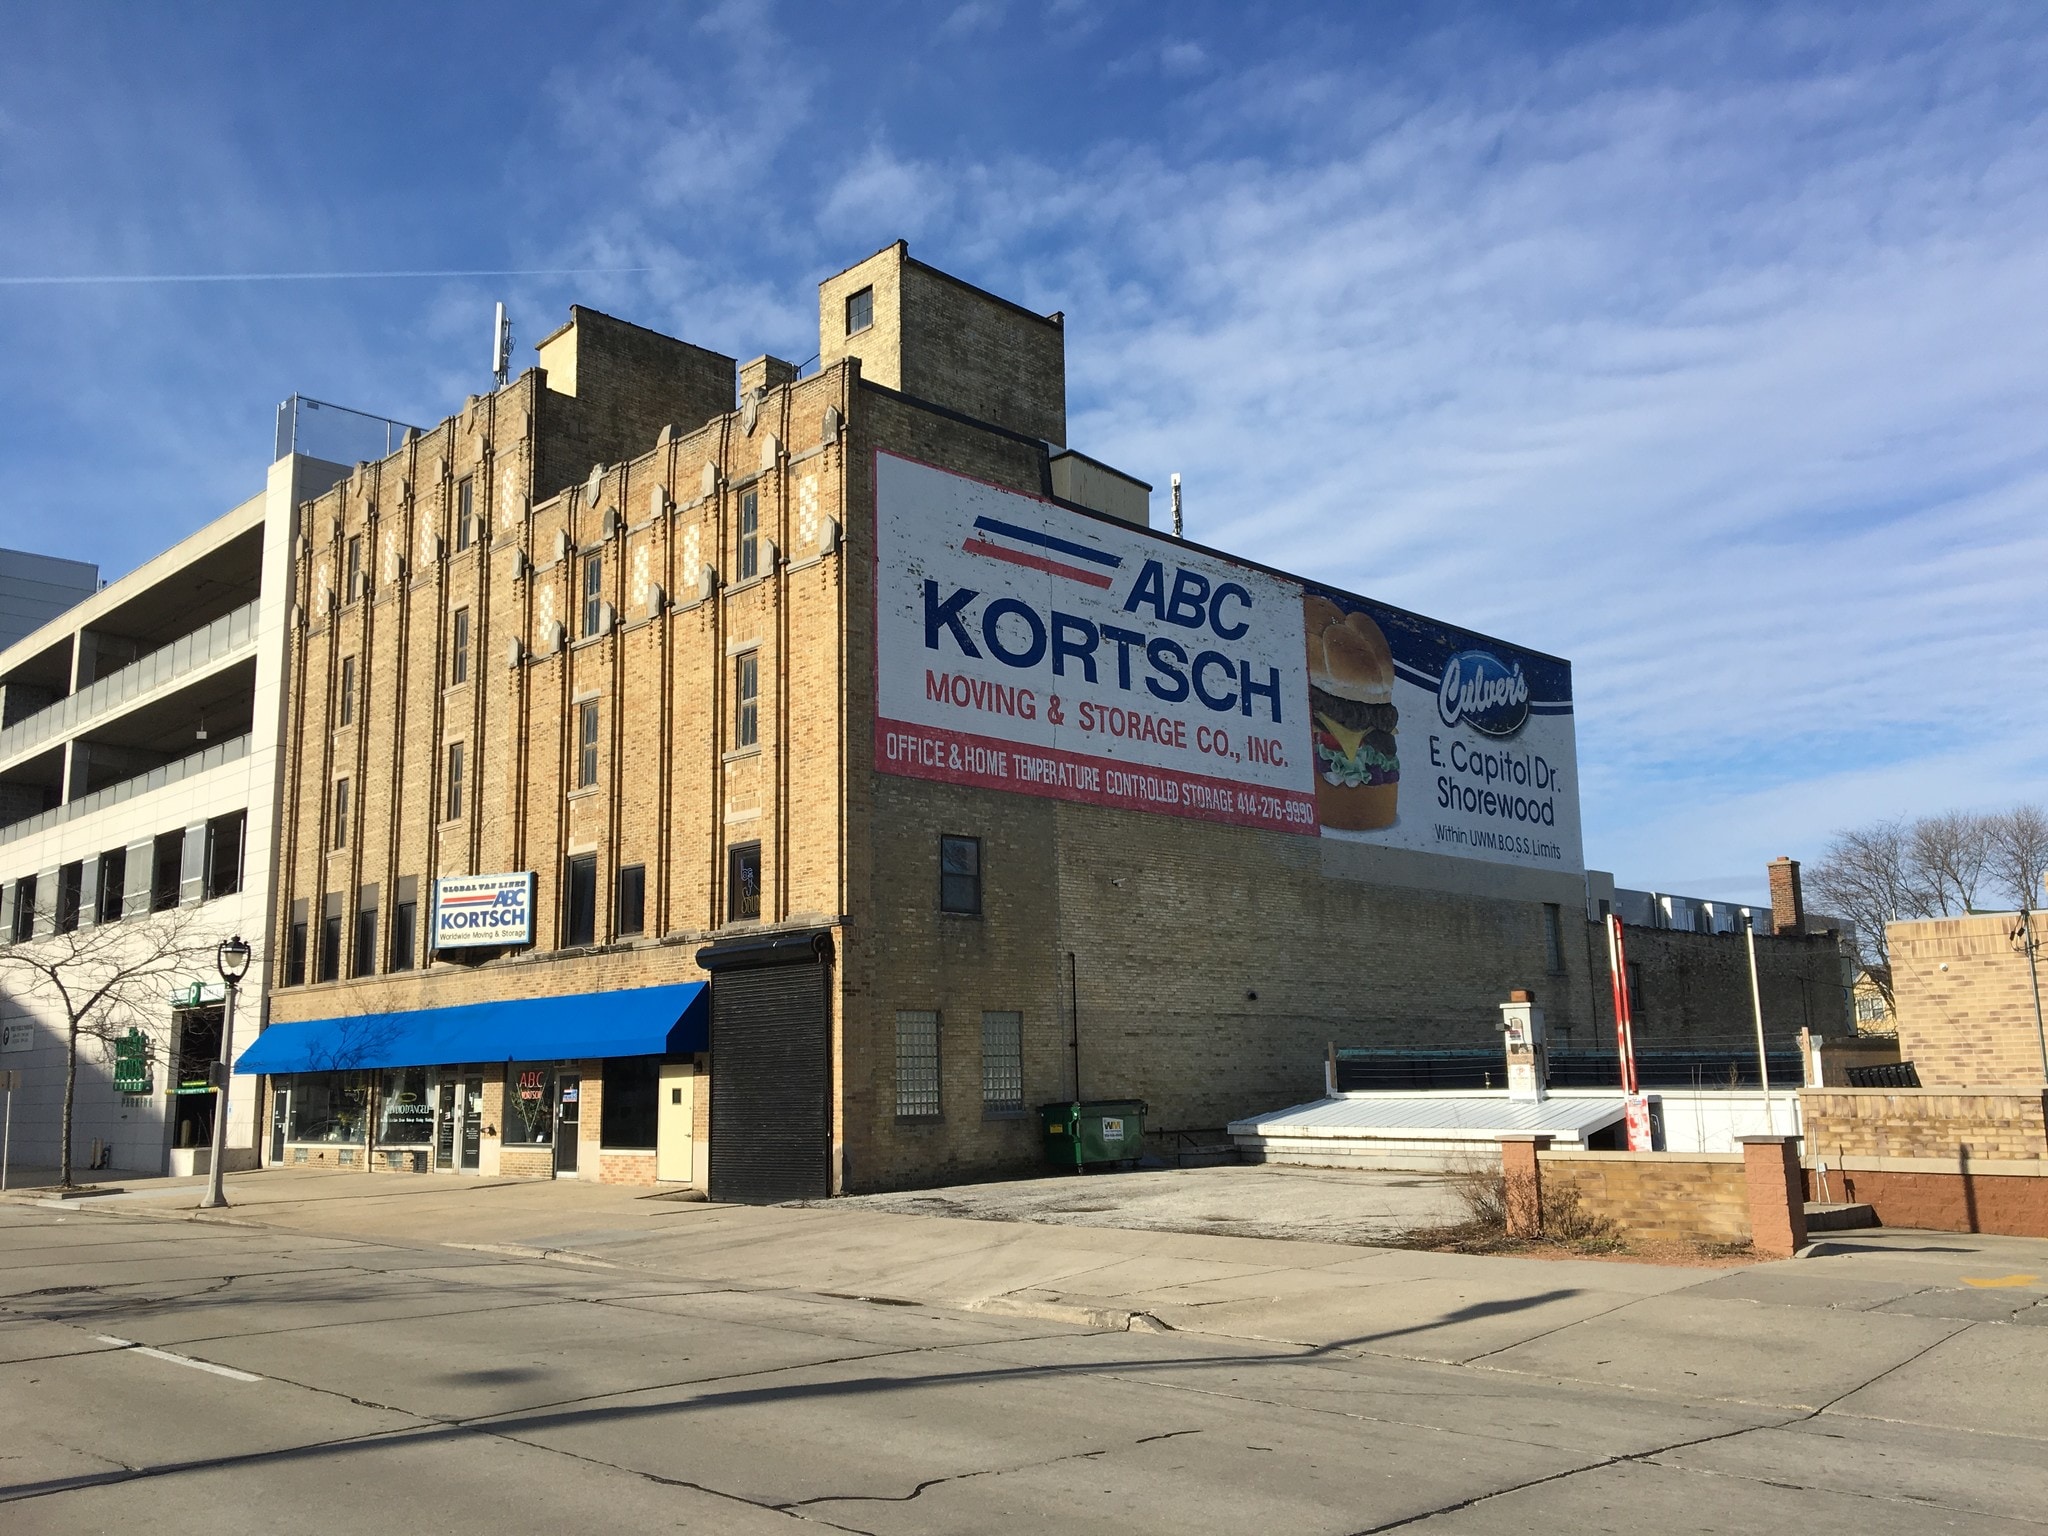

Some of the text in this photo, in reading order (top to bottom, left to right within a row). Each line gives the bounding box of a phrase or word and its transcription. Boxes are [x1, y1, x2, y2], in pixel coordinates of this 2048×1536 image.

[1123, 559, 1252, 641] ABC
[924, 579, 1282, 724] KORTSCH
[1440, 658, 1529, 723] Culver's
[926, 669, 1289, 767] MOVING & STORAGE CO., INC.
[886, 732, 945, 768] OFFICE
[964, 746, 1008, 778] HOME
[1012, 754, 1100, 792] TEMPERATURE
[1106, 770, 1179, 804] CONTROLLED
[1182, 782, 1234, 813] STORAGE
[1237, 792, 1314, 824] 414-276-9990
[1429, 735, 1561, 793] E. Capitol Dr.
[1437, 776, 1555, 827] Shorewood
[1434, 823, 1468, 845] Within
[1532, 839, 1561, 860] Limits
[443, 884, 477, 893] GLOBAL
[498, 880, 526, 889] LINES
[492, 888, 526, 909] ABC
[440, 929, 526, 941] Worldwide Moving & Storage
[441, 908, 525, 930] KORTSCH
[519, 1071, 544, 1088] ABC
[121, 1097, 153, 1108] PARKING
